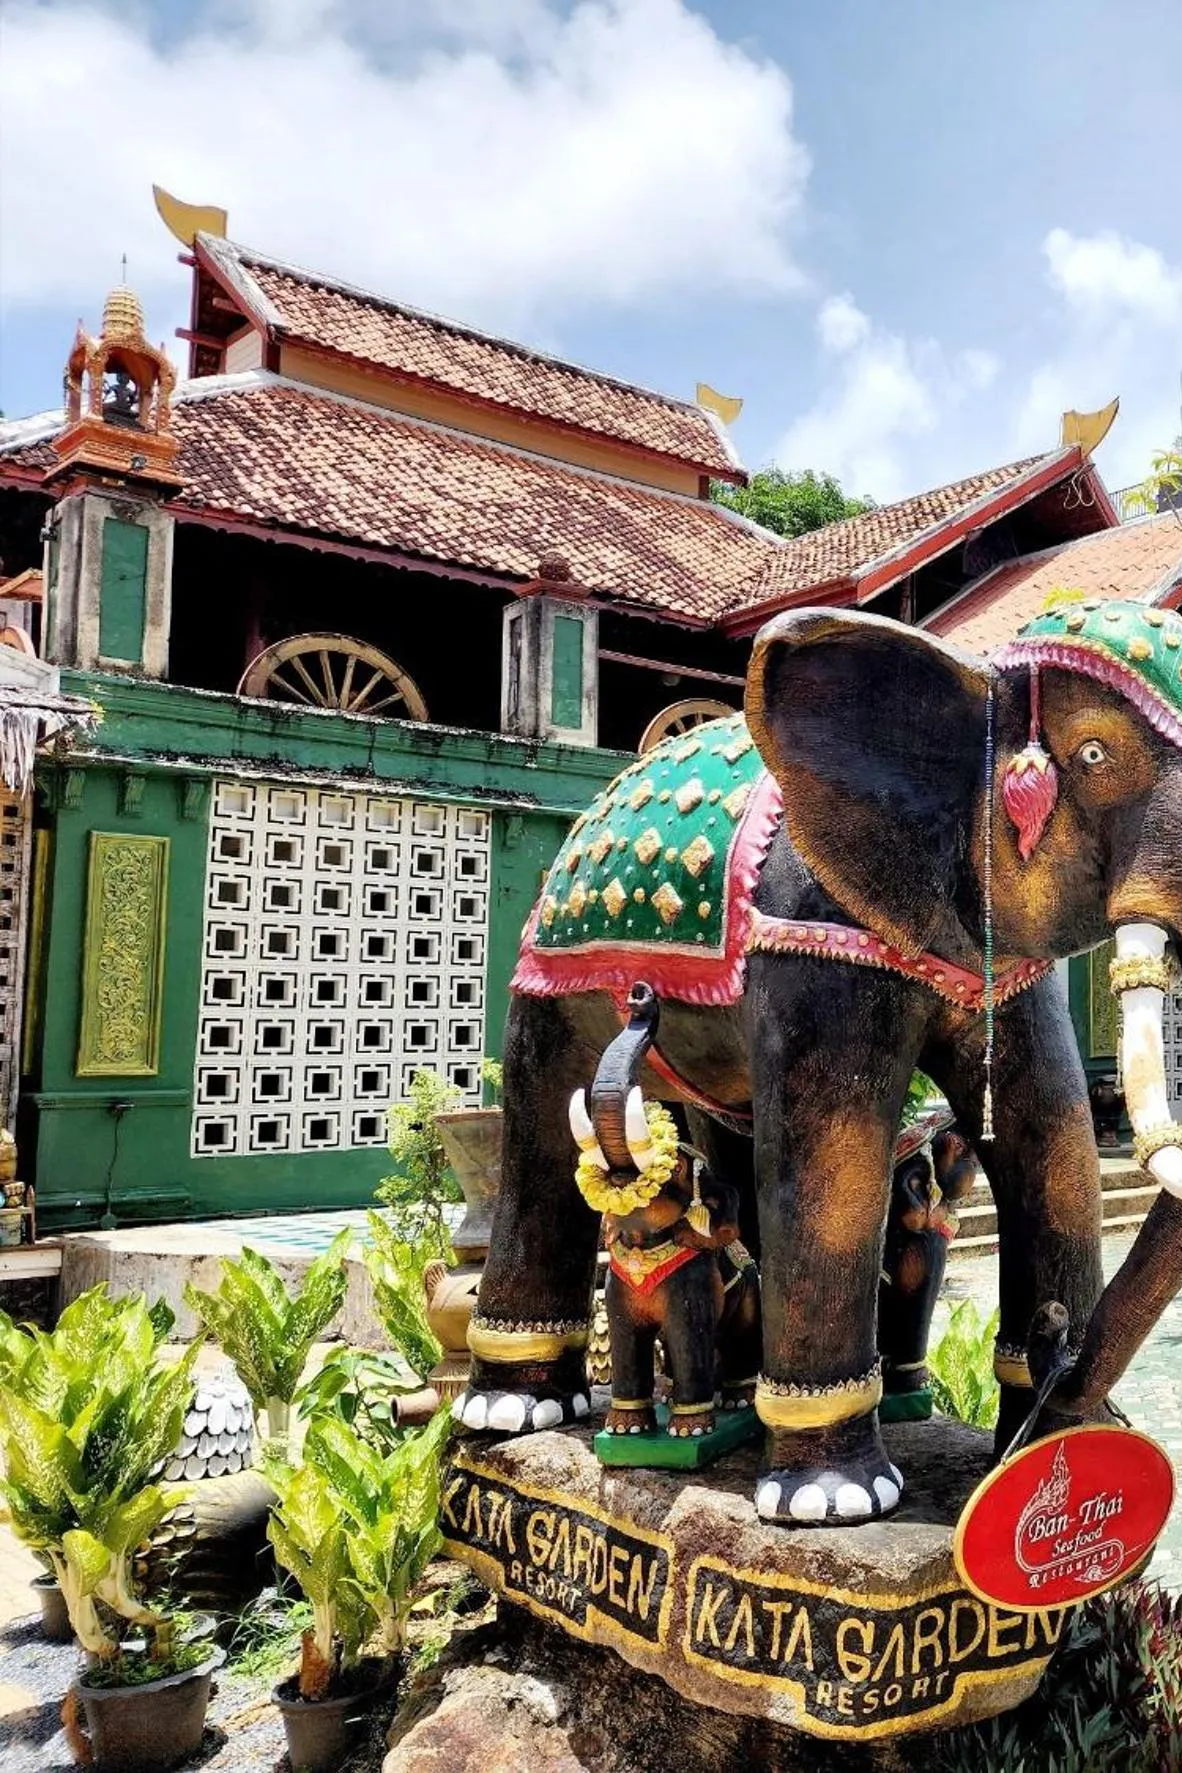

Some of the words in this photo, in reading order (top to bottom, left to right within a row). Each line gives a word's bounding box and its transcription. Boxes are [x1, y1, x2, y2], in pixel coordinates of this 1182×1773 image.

[441, 1476, 516, 1555] KATA
[527, 1511, 658, 1621] GARDEN
[1029, 1546, 1114, 1588] Restaurant
[511, 1560, 582, 1611] RESORT
[695, 1582, 814, 1672] KATA
[836, 1600, 1066, 1683] GARDEN
[816, 1670, 949, 1715] RESORT
